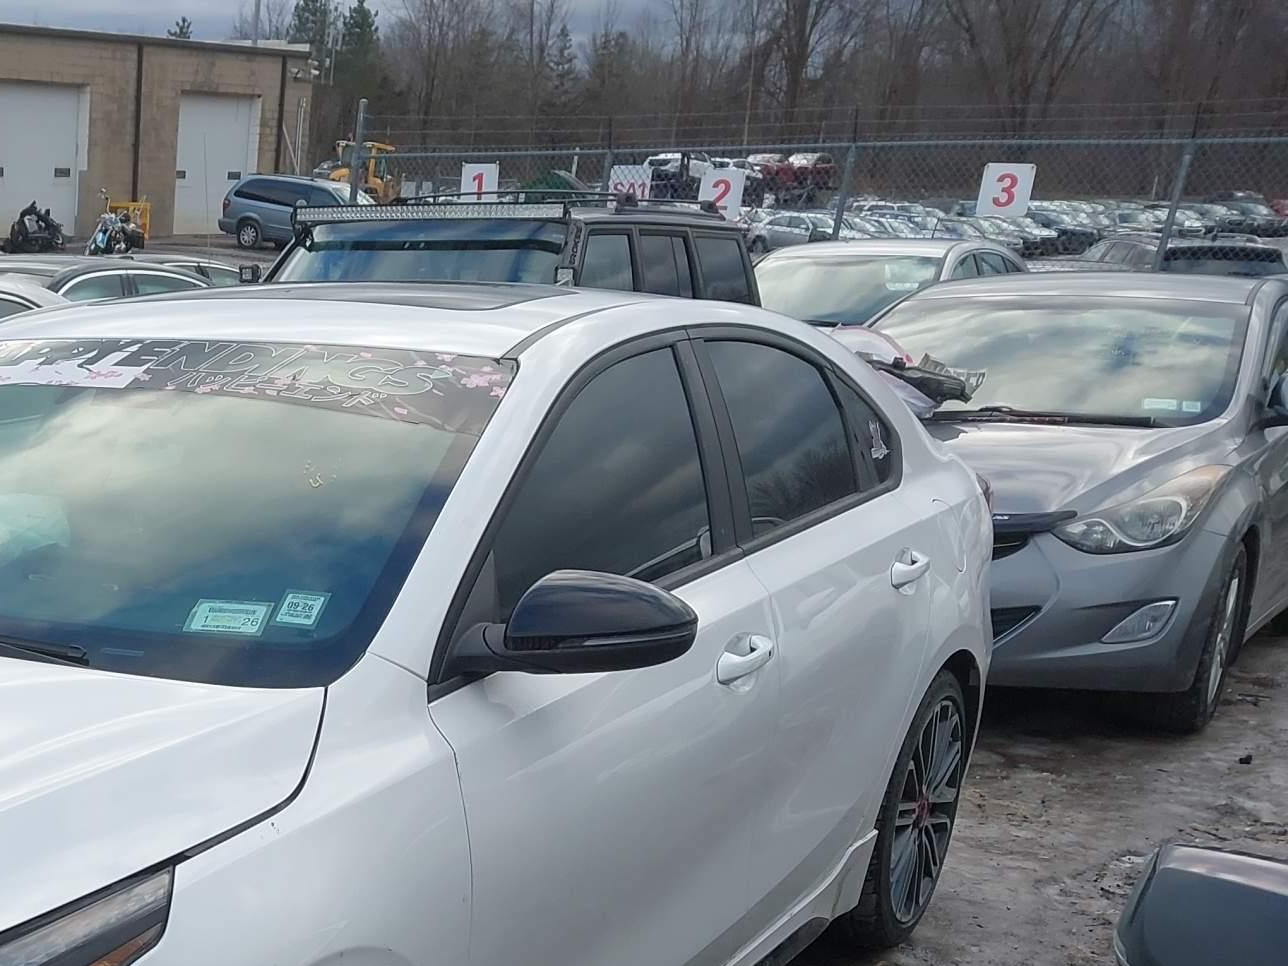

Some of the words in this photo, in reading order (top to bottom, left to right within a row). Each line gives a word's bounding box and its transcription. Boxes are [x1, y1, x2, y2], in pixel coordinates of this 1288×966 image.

[472, 172, 484, 200] 1
[712, 178, 732, 211] 2
[991, 172, 1019, 208] 3
[111, 339, 451, 395] ENDINGS
[241, 618, 259, 627] 26
